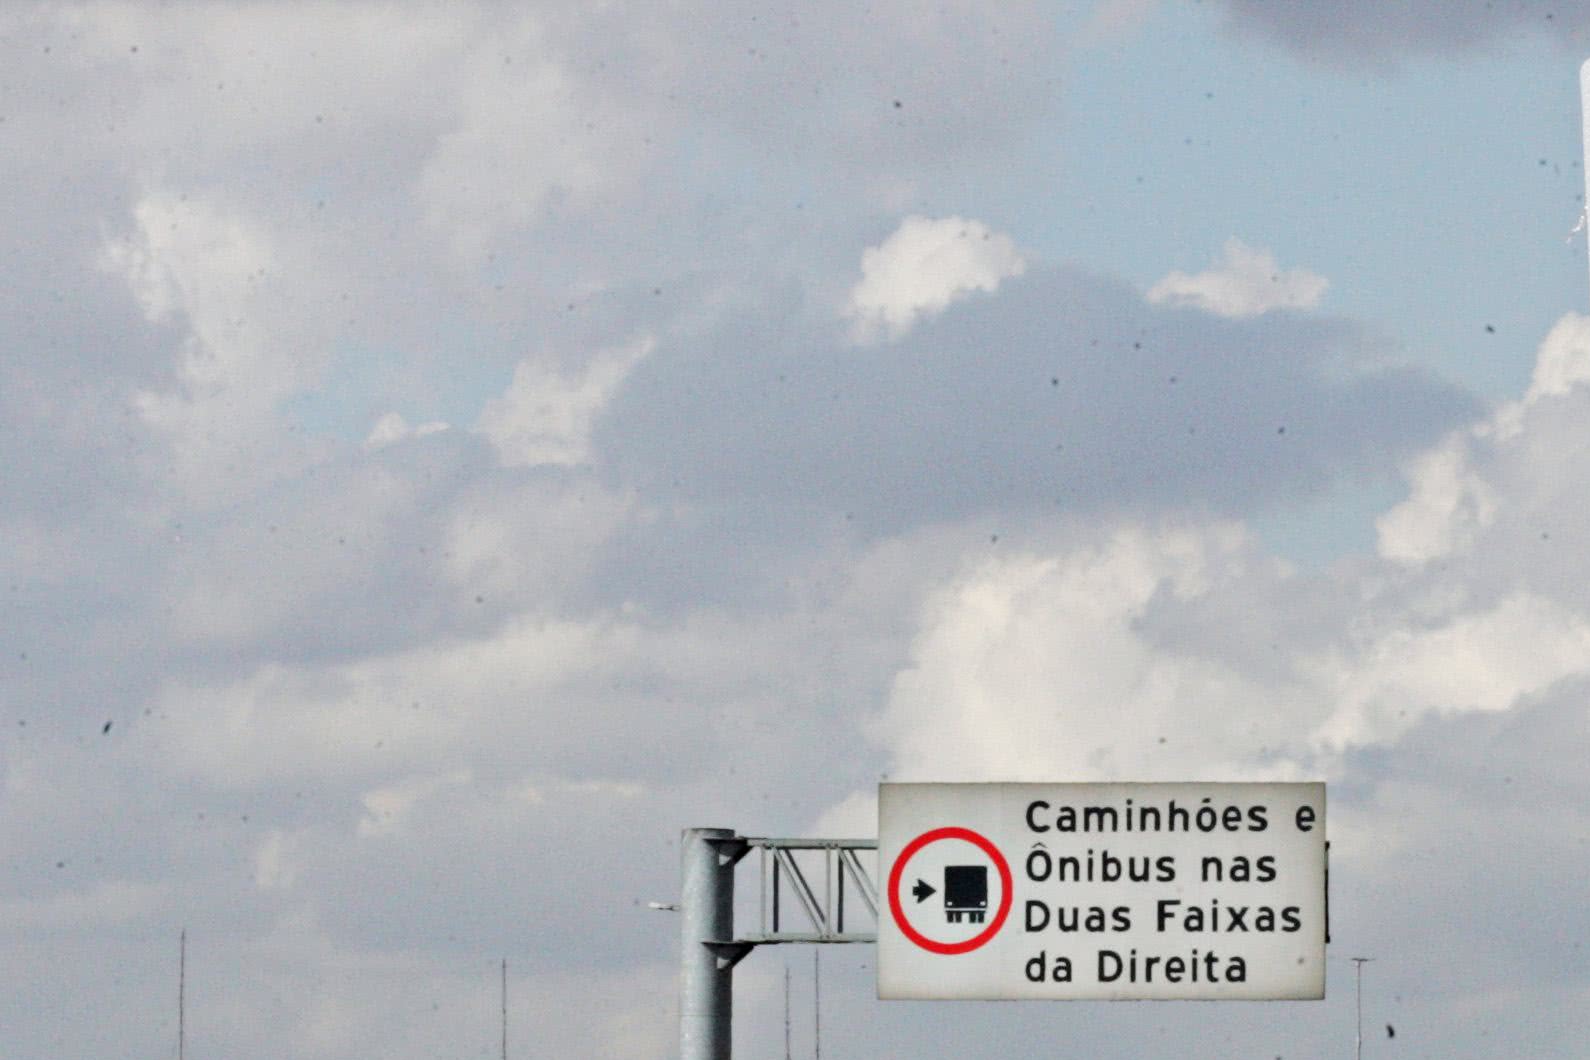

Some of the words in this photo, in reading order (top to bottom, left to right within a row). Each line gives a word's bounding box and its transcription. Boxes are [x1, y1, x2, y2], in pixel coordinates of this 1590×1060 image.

[1295, 805, 1316, 832] e
[1025, 841, 1176, 882] Ônibus
[1201, 855, 1277, 882] nas
[1024, 900, 1132, 933] Duas
[1157, 899, 1302, 933] Faixas
[1025, 950, 1073, 983] da
[1098, 949, 1247, 983] Direita
